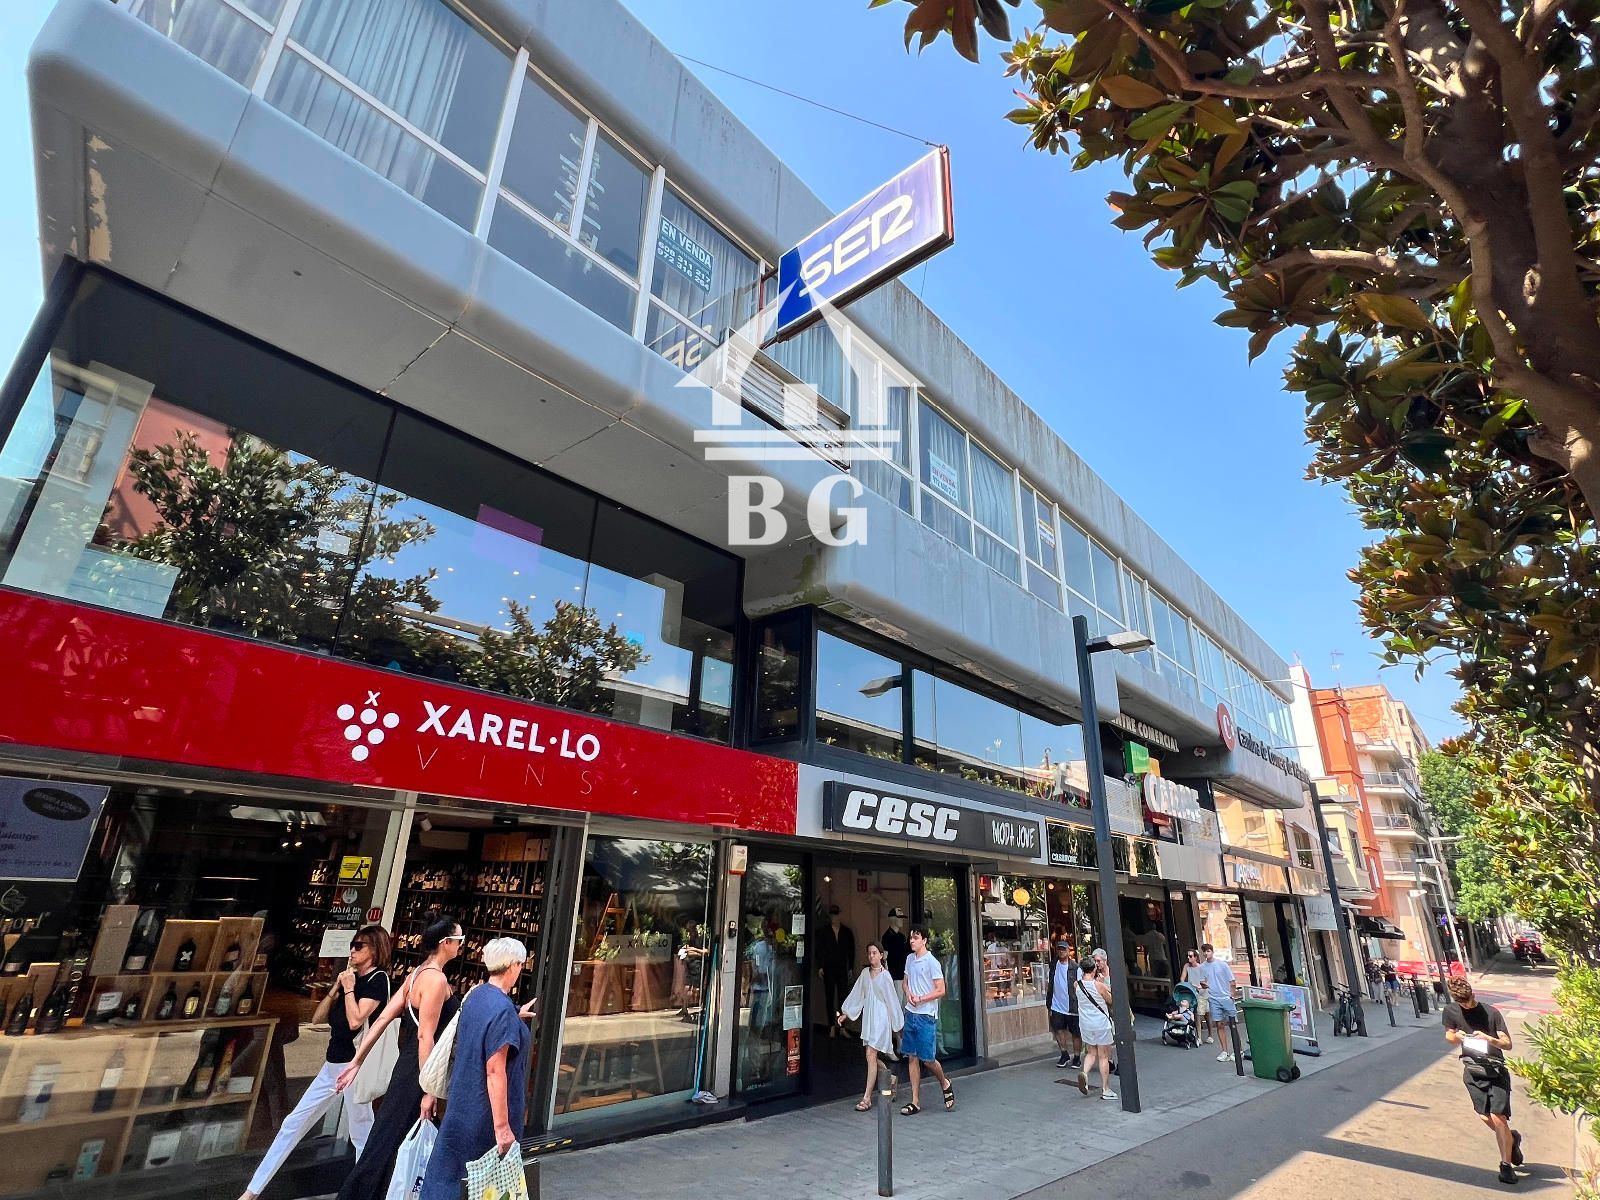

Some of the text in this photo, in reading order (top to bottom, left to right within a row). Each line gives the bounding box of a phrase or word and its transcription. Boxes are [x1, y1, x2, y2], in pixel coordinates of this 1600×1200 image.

[662, 220, 676, 240] EN
[679, 233, 711, 268] VENDA
[1137, 721, 1180, 753] COMERCIAL
[417, 744, 593, 795] VINS
[1016, 827, 1036, 849] JOVE
